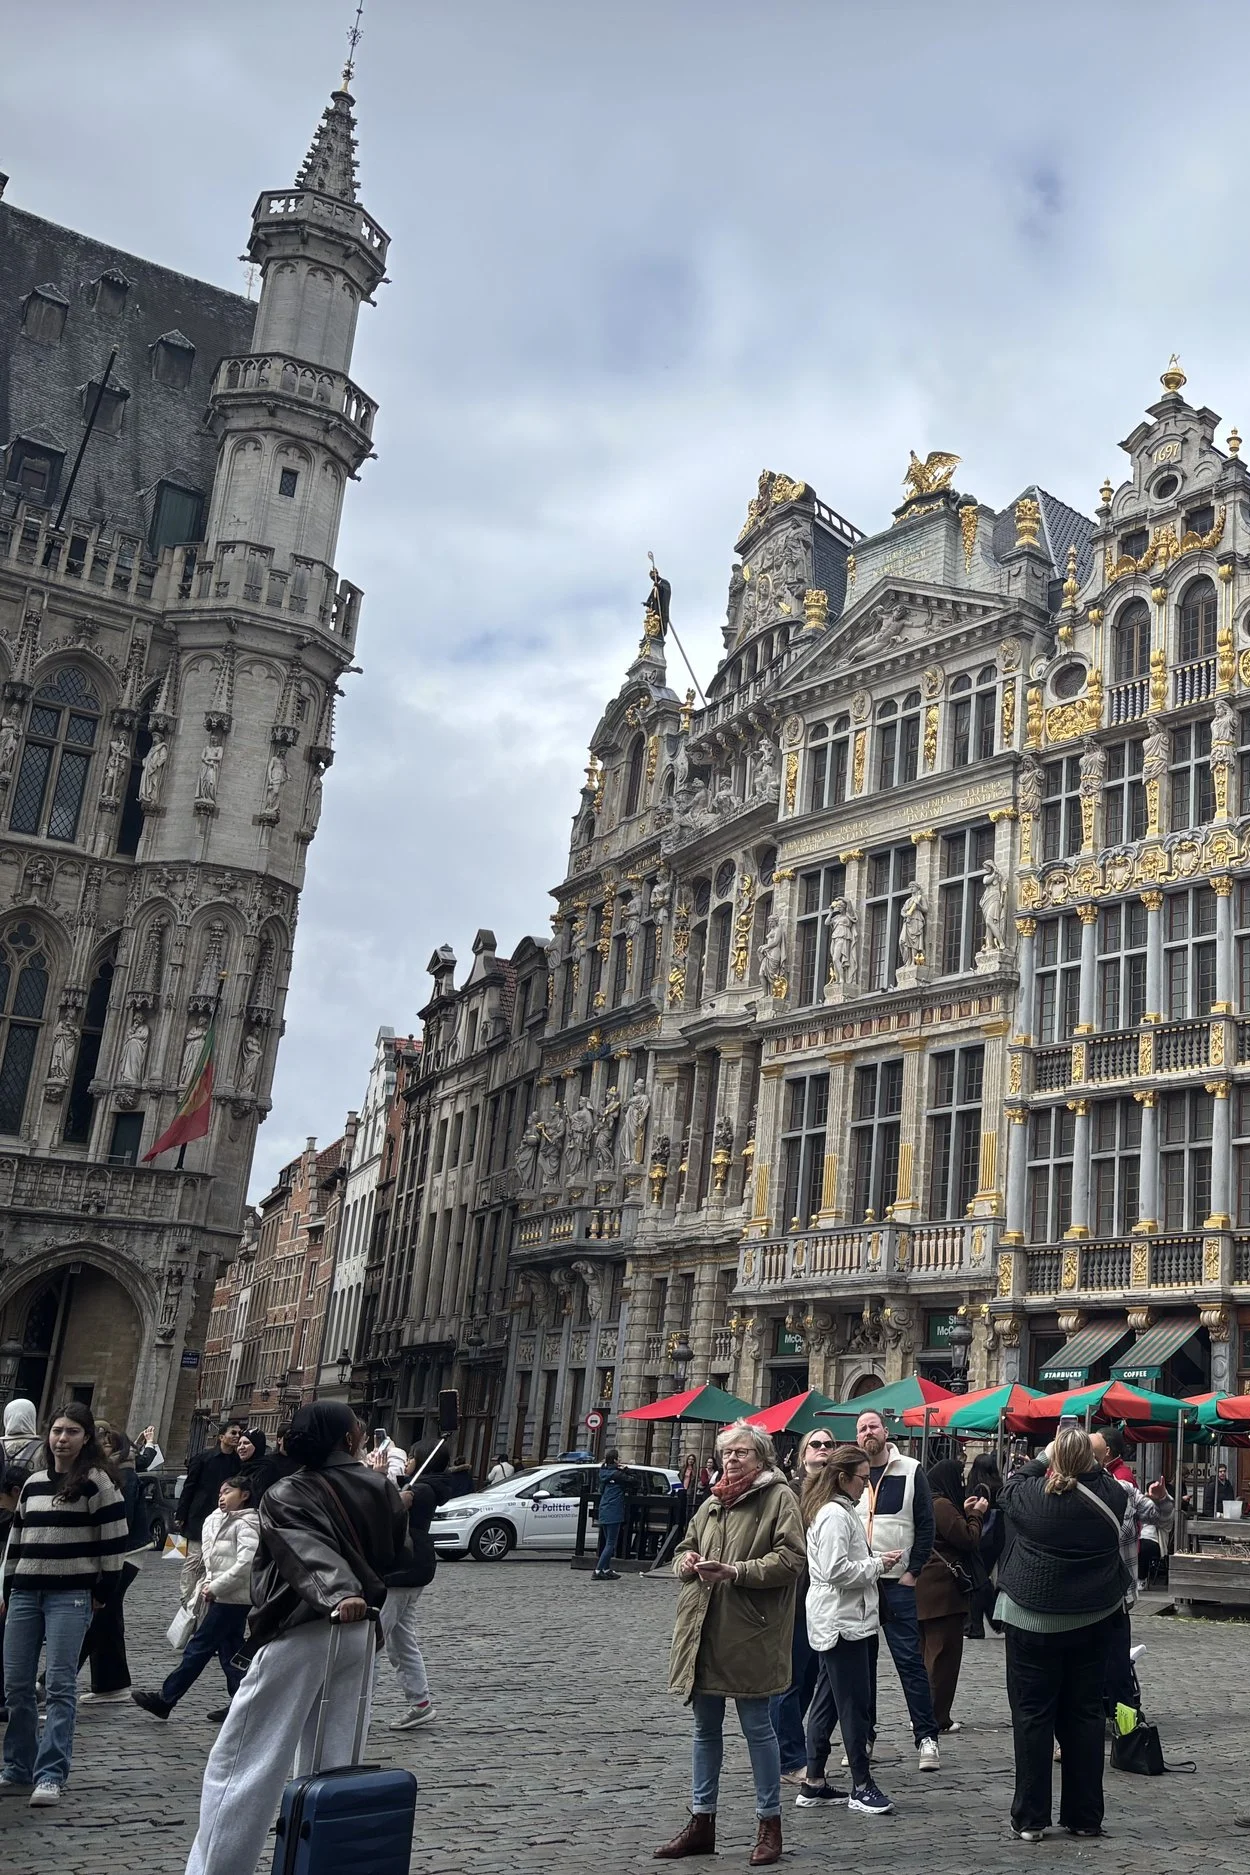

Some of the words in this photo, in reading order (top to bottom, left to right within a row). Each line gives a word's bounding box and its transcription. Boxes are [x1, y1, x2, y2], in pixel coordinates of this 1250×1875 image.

[1153, 442, 1180, 464] 1697
[1044, 1371, 1082, 1379] STARBUCKS
[1123, 1370, 1147, 1378] COFFEE
[542, 1503, 571, 1512] Politie
